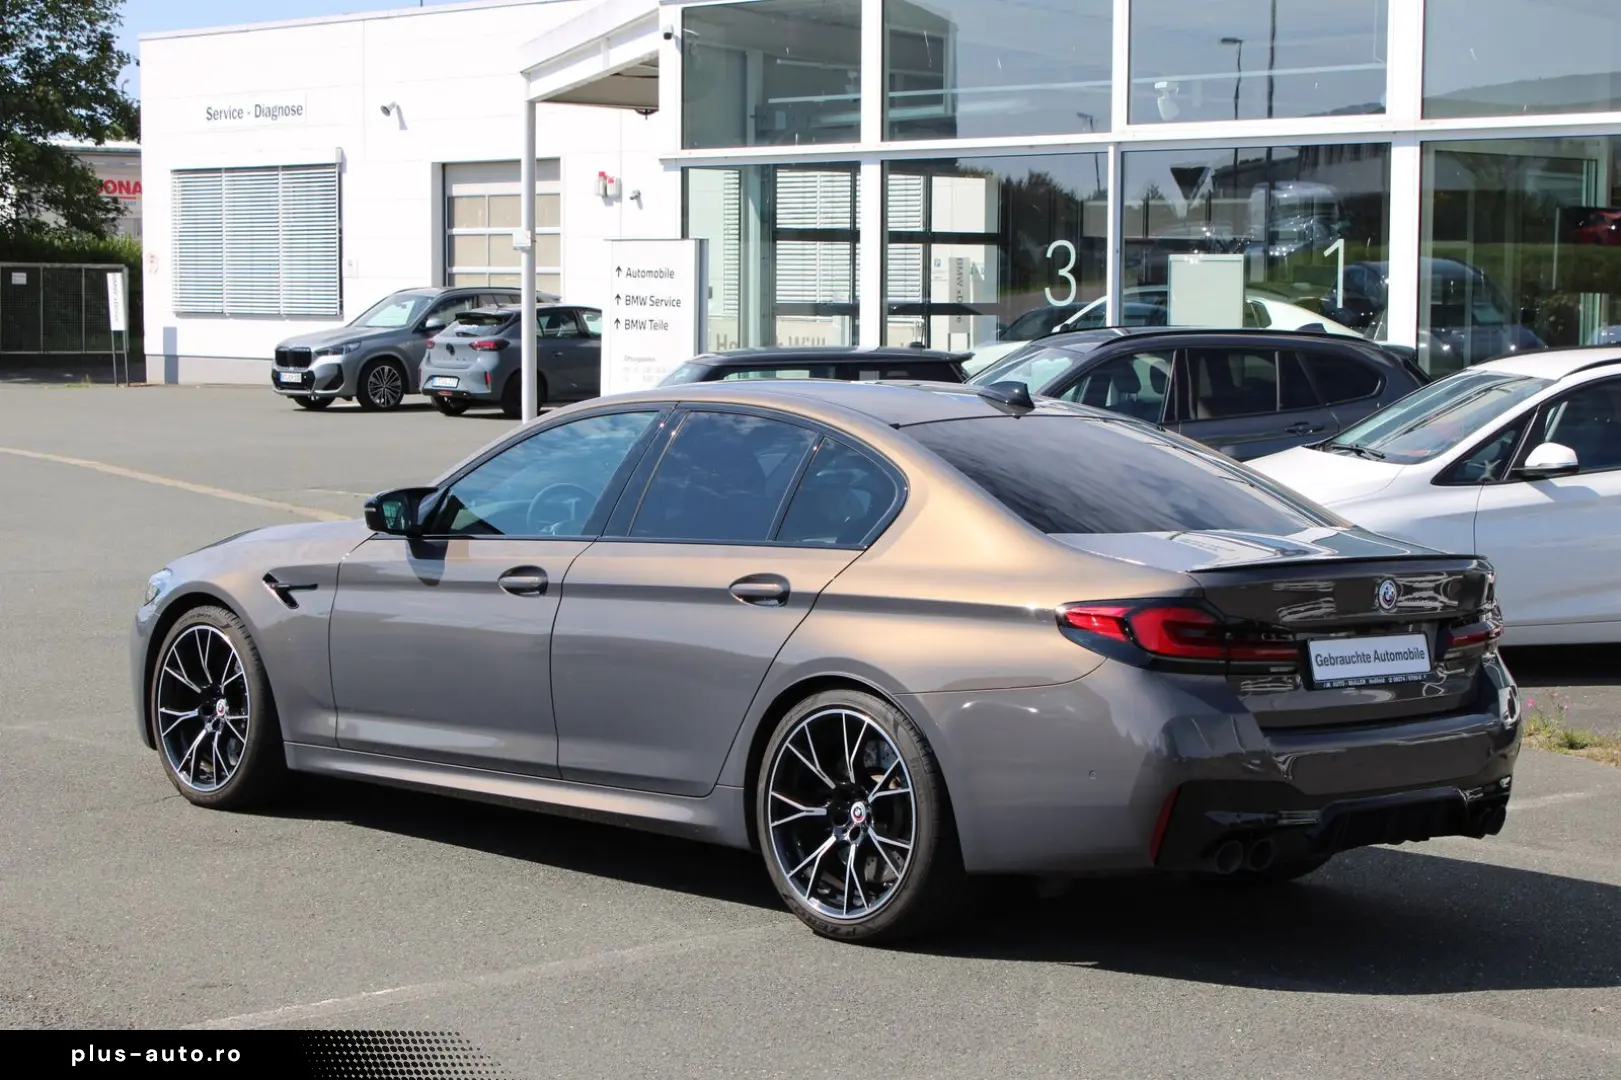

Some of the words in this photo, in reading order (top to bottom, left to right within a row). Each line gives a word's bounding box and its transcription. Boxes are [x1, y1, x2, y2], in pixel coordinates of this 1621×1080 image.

[206, 105, 244, 121] Service
[254, 103, 303, 121] Diagnose
[97, 179, 142, 195] ONA
[625, 267, 675, 279] Automobile
[1044, 239, 1077, 306] 3
[1323, 238, 1344, 308] 1
[625, 295, 648, 306] BMW
[649, 295, 682, 308] Service
[624, 319, 647, 330] BMW
[648, 319, 669, 331] Teile
[1315, 651, 1372, 667] Gebrauchte
[1373, 647, 1425, 662] Automobile
